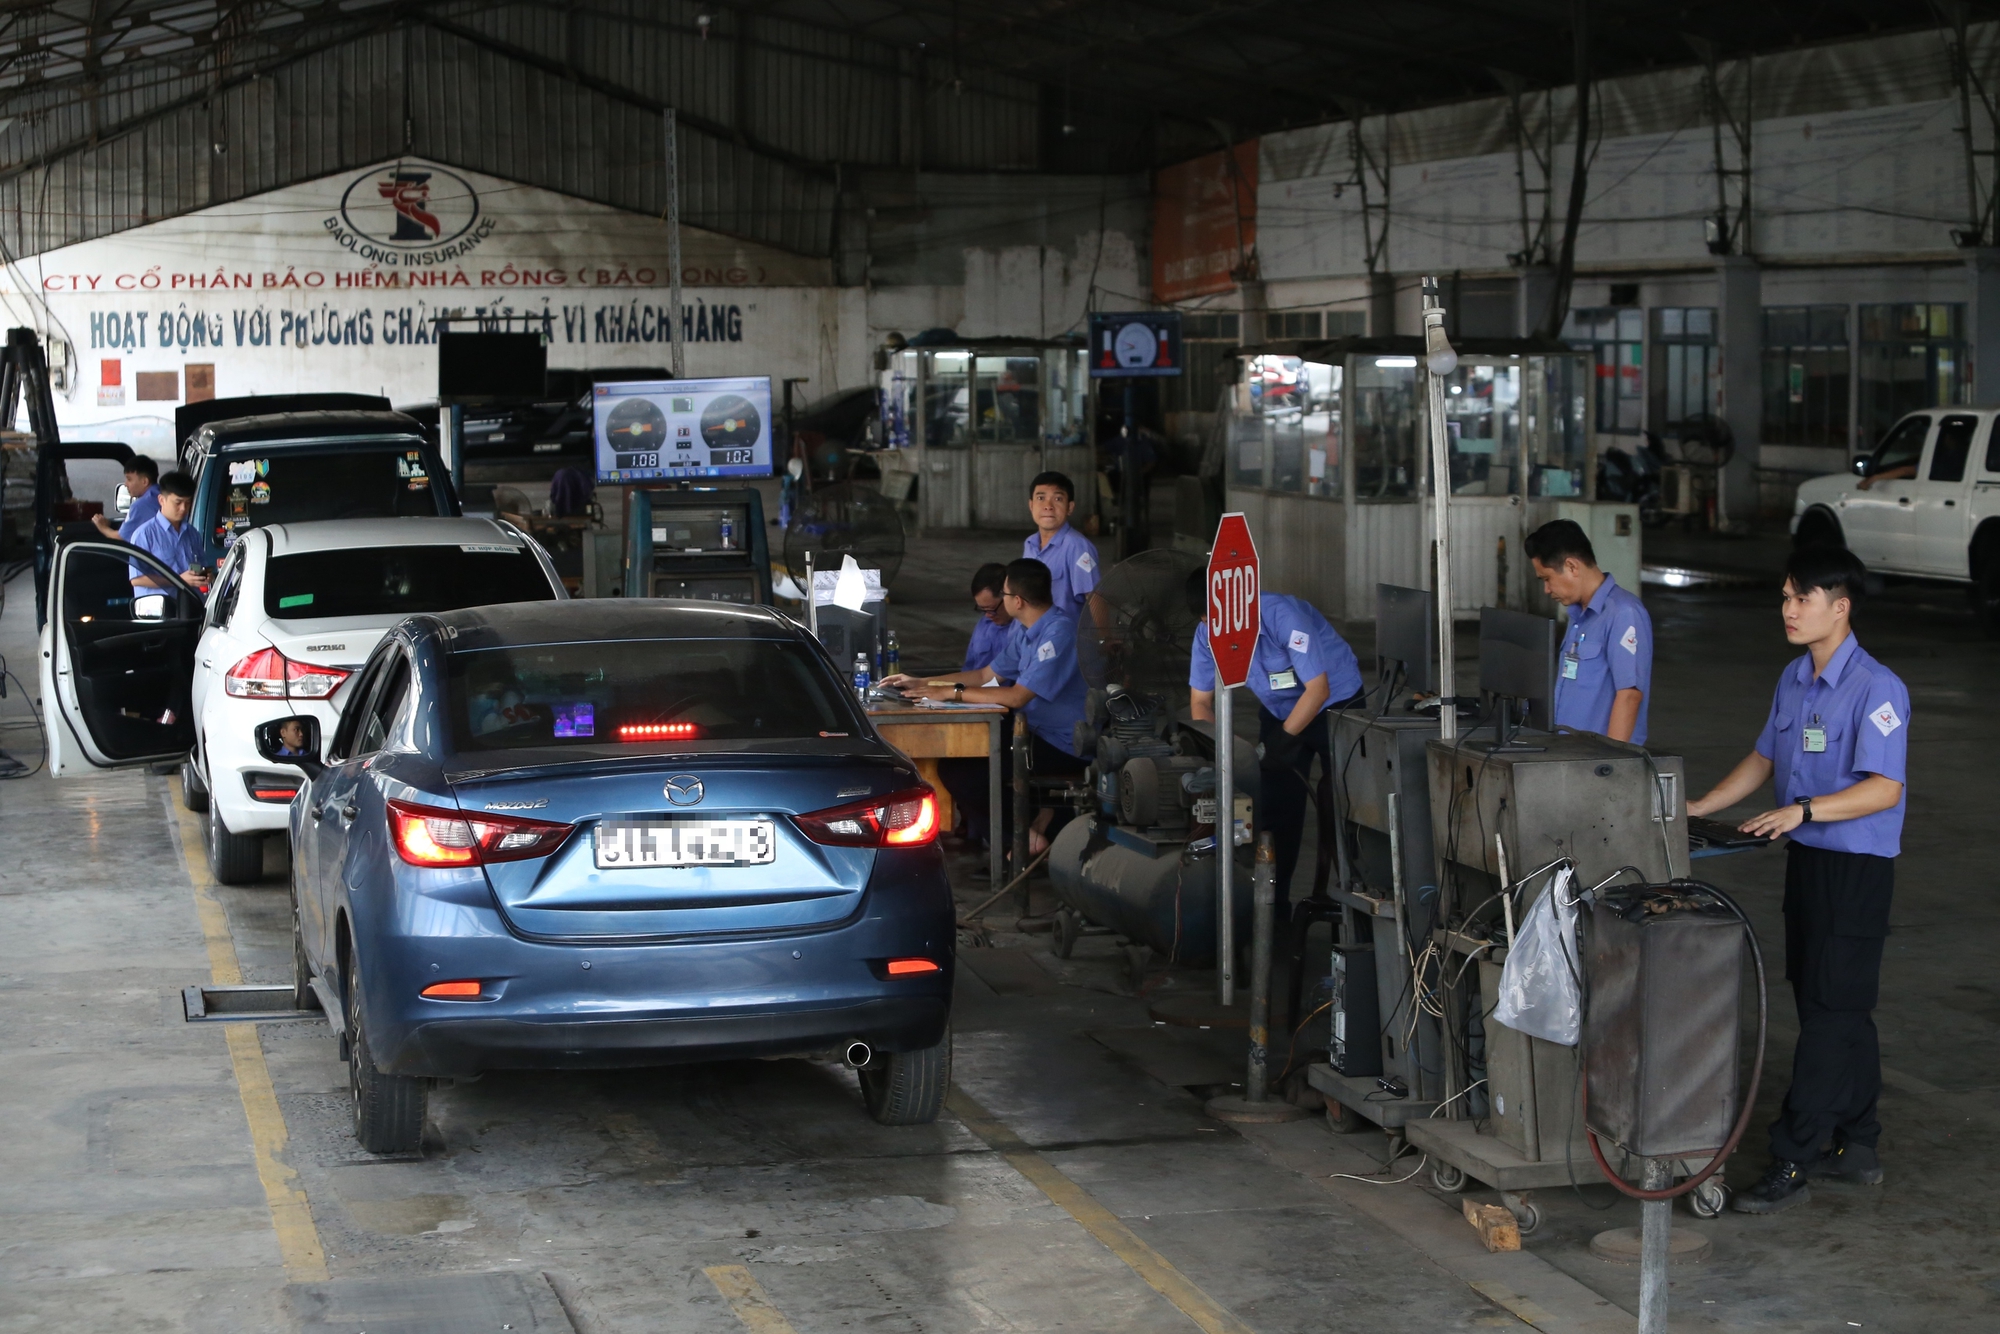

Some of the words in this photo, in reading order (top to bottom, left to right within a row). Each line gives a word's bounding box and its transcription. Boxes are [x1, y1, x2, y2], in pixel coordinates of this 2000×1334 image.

[324, 216, 398, 266] BAOLONG
[404, 216, 497, 266] INSURANCE
[43, 274, 102, 290] CTY
[115, 265, 161, 290] CỔ
[171, 266, 252, 289] PHẦN
[263, 265, 325, 288] BẢO
[336, 263, 398, 287] HIỂM
[409, 264, 470, 286] NHÀ
[482, 262, 567, 286] RỒNG
[90, 310, 148, 354] HOẠT
[158, 301, 223, 354] ĐỘNG
[563, 302, 586, 343] VÌ
[595, 297, 671, 343] KHÁCH
[726, 450, 751, 464] 1.02
[1211, 564, 1255, 637] STOP
[306, 644, 346, 652] SUZUKI
